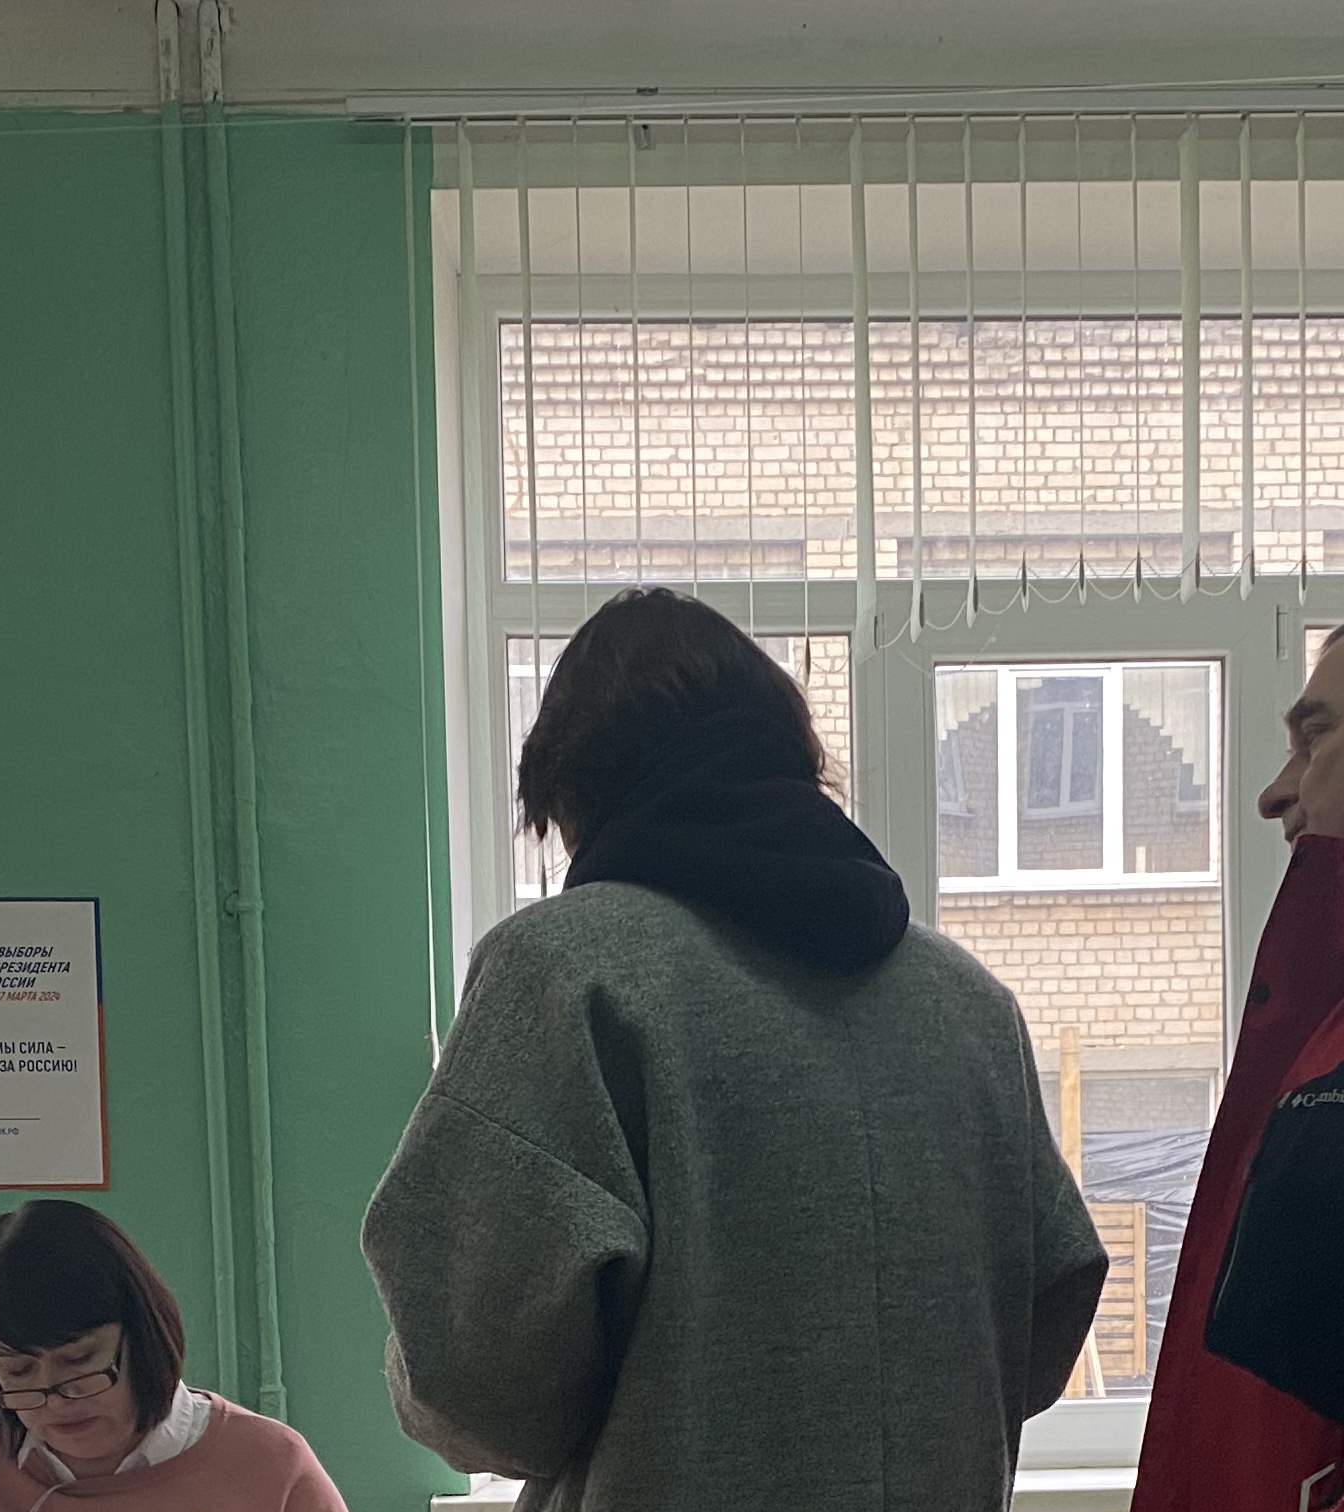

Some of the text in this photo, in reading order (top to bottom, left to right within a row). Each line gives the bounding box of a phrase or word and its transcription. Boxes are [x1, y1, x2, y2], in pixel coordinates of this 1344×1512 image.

[7, 991, 37, 1001] МАРТА
[19, 1041, 54, 1055] СИЛА
[0, 1060, 15, 1073] ЗА
[18, 1059, 77, 1073] РОССИЮ!
